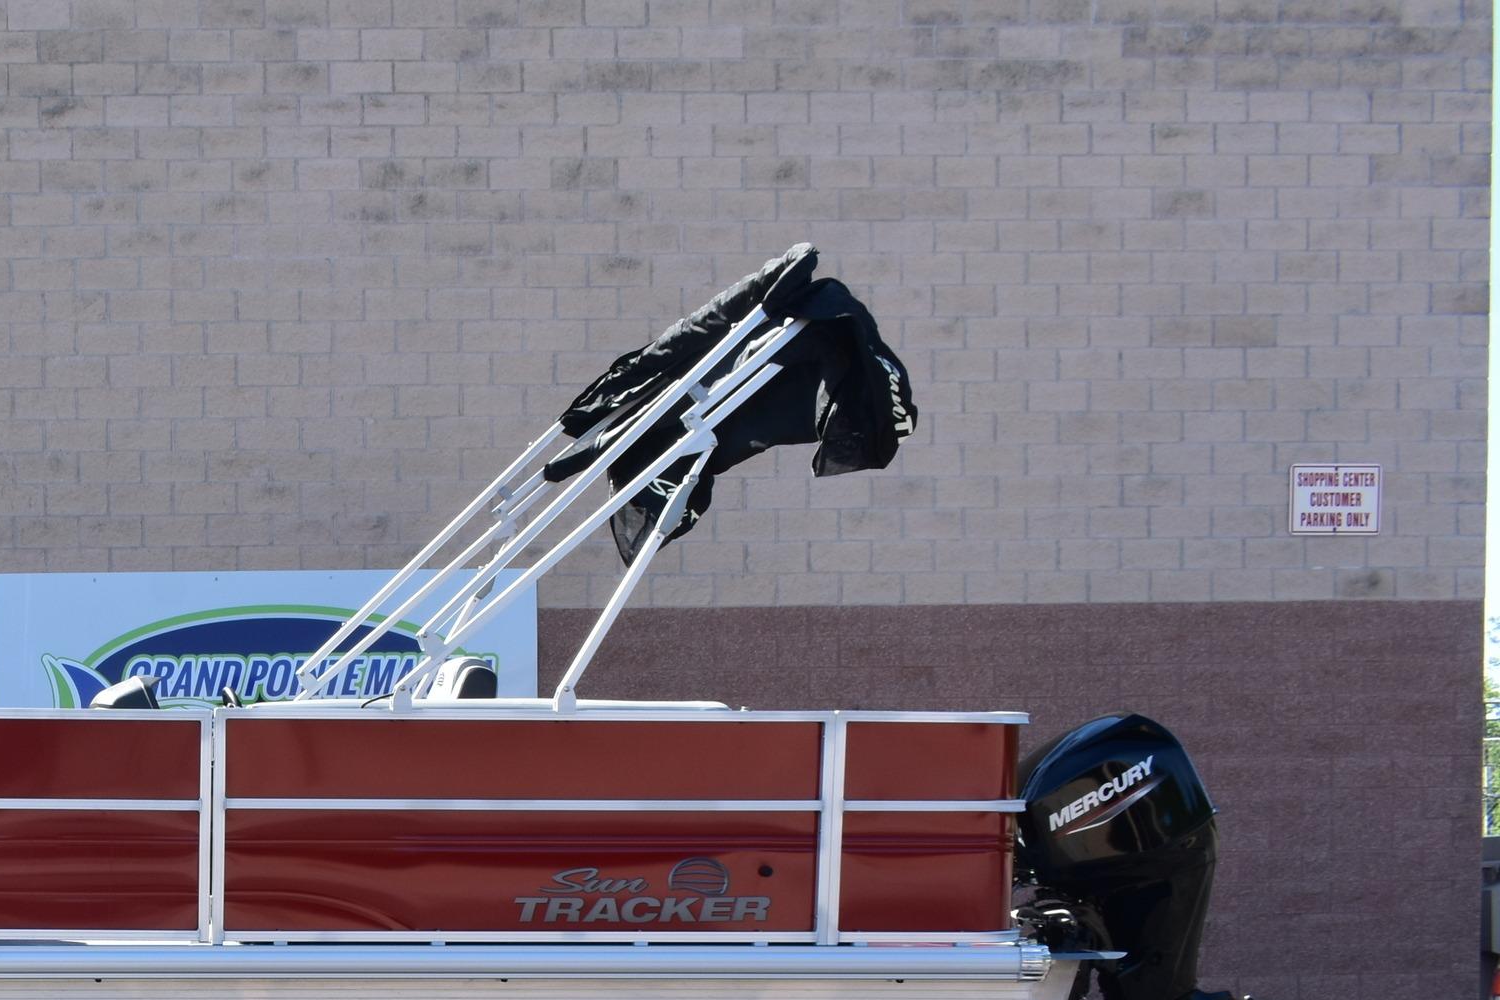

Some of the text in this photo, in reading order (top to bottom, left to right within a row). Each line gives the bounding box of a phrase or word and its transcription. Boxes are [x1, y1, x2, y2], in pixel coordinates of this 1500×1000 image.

[1297, 472, 1375, 487] SHOPPING CENTER
[1310, 492, 1362, 507] CUSTOMER
[1300, 512, 1370, 527] PARKING ONLY
[1048, 755, 1154, 831] MERCURY
[537, 867, 649, 894] Sun
[514, 897, 772, 923] TRACKER
